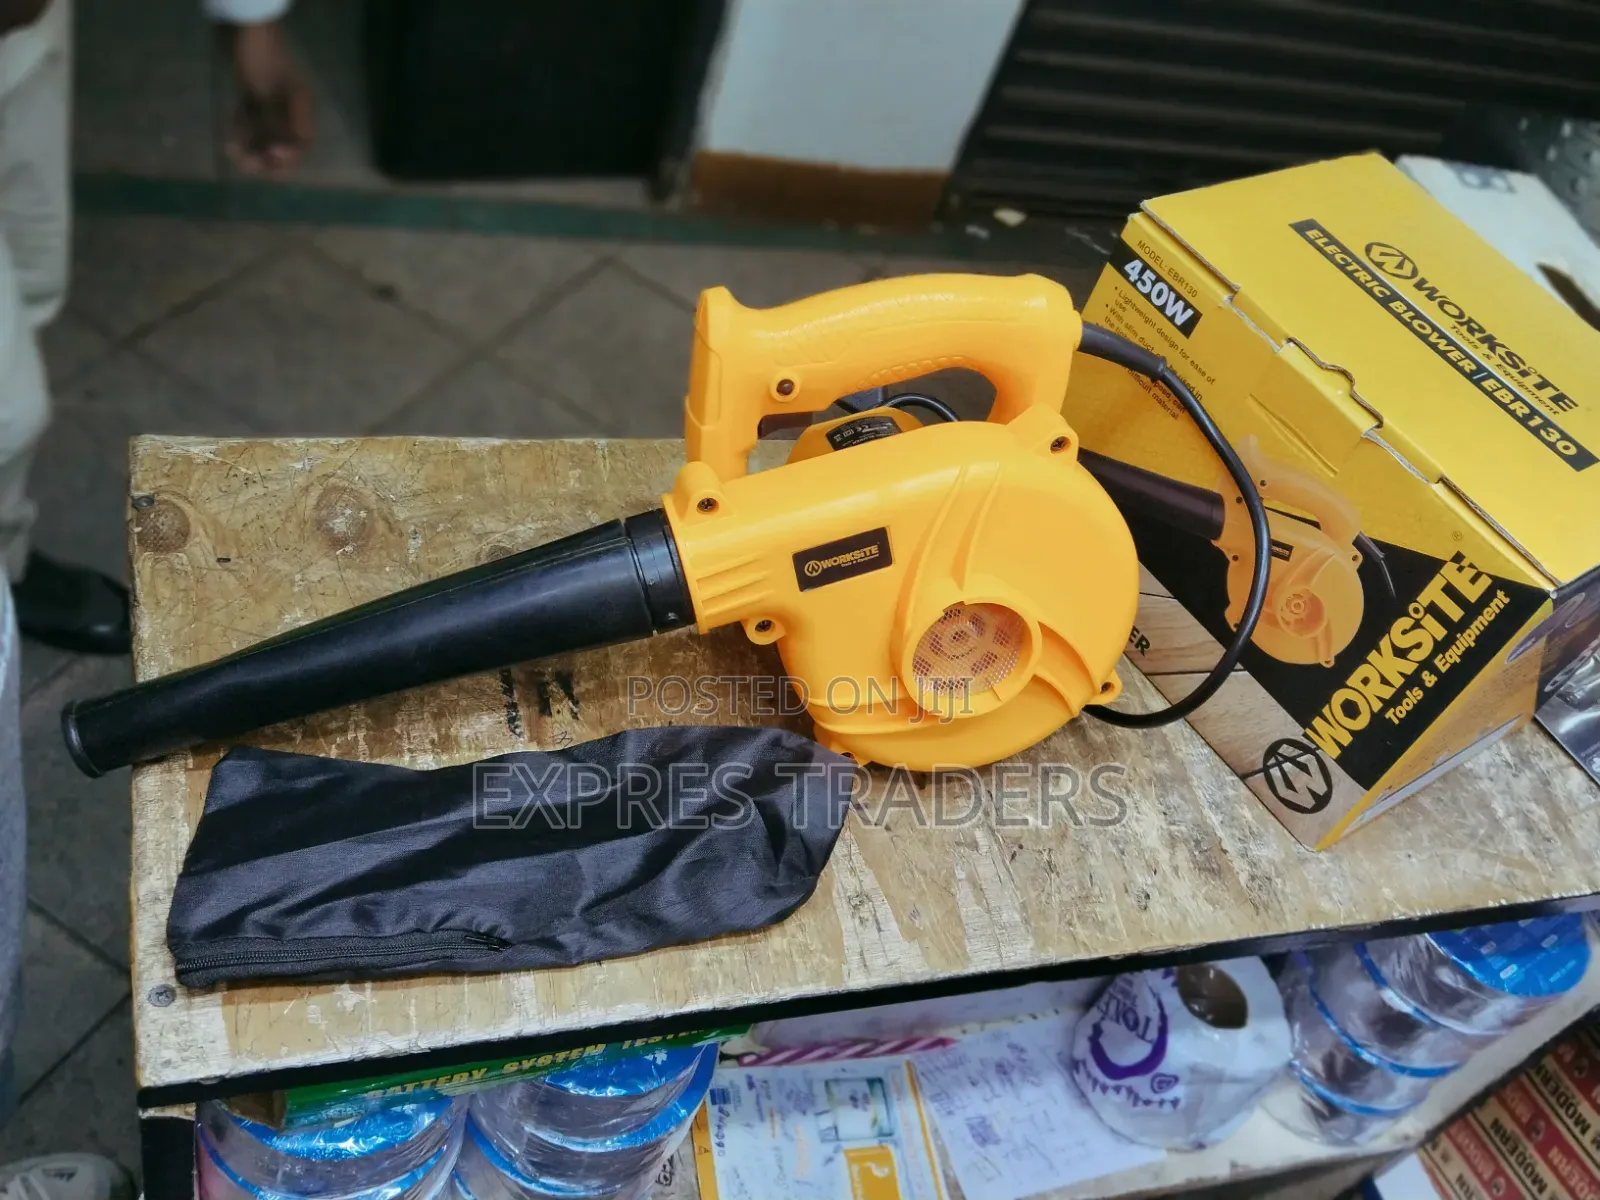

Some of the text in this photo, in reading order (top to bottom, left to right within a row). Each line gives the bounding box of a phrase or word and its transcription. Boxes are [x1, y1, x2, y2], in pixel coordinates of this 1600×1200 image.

[1124, 259, 1194, 327] 450W
[1137, 239, 1198, 298] MODEL: EBR130
[1104, 315, 1115, 329] the
[1109, 307, 1124, 325] With
[1114, 299, 1128, 313] use
[1118, 289, 1157, 332] Lightweight
[1157, 327, 1179, 351] design
[1179, 348, 1190, 361] for
[1190, 359, 1206, 376] ease
[1206, 373, 1215, 386] of
[1304, 228, 1578, 457] ELECTRIC BLOWER EBR130
[1449, 324, 1480, 351] Tools
[1495, 362, 1560, 416] Equipment
[1151, 392, 1179, 420] material
[1384, 589, 1511, 726] Tools & Equipment
[1489, 1117, 1548, 1195] MODERN
